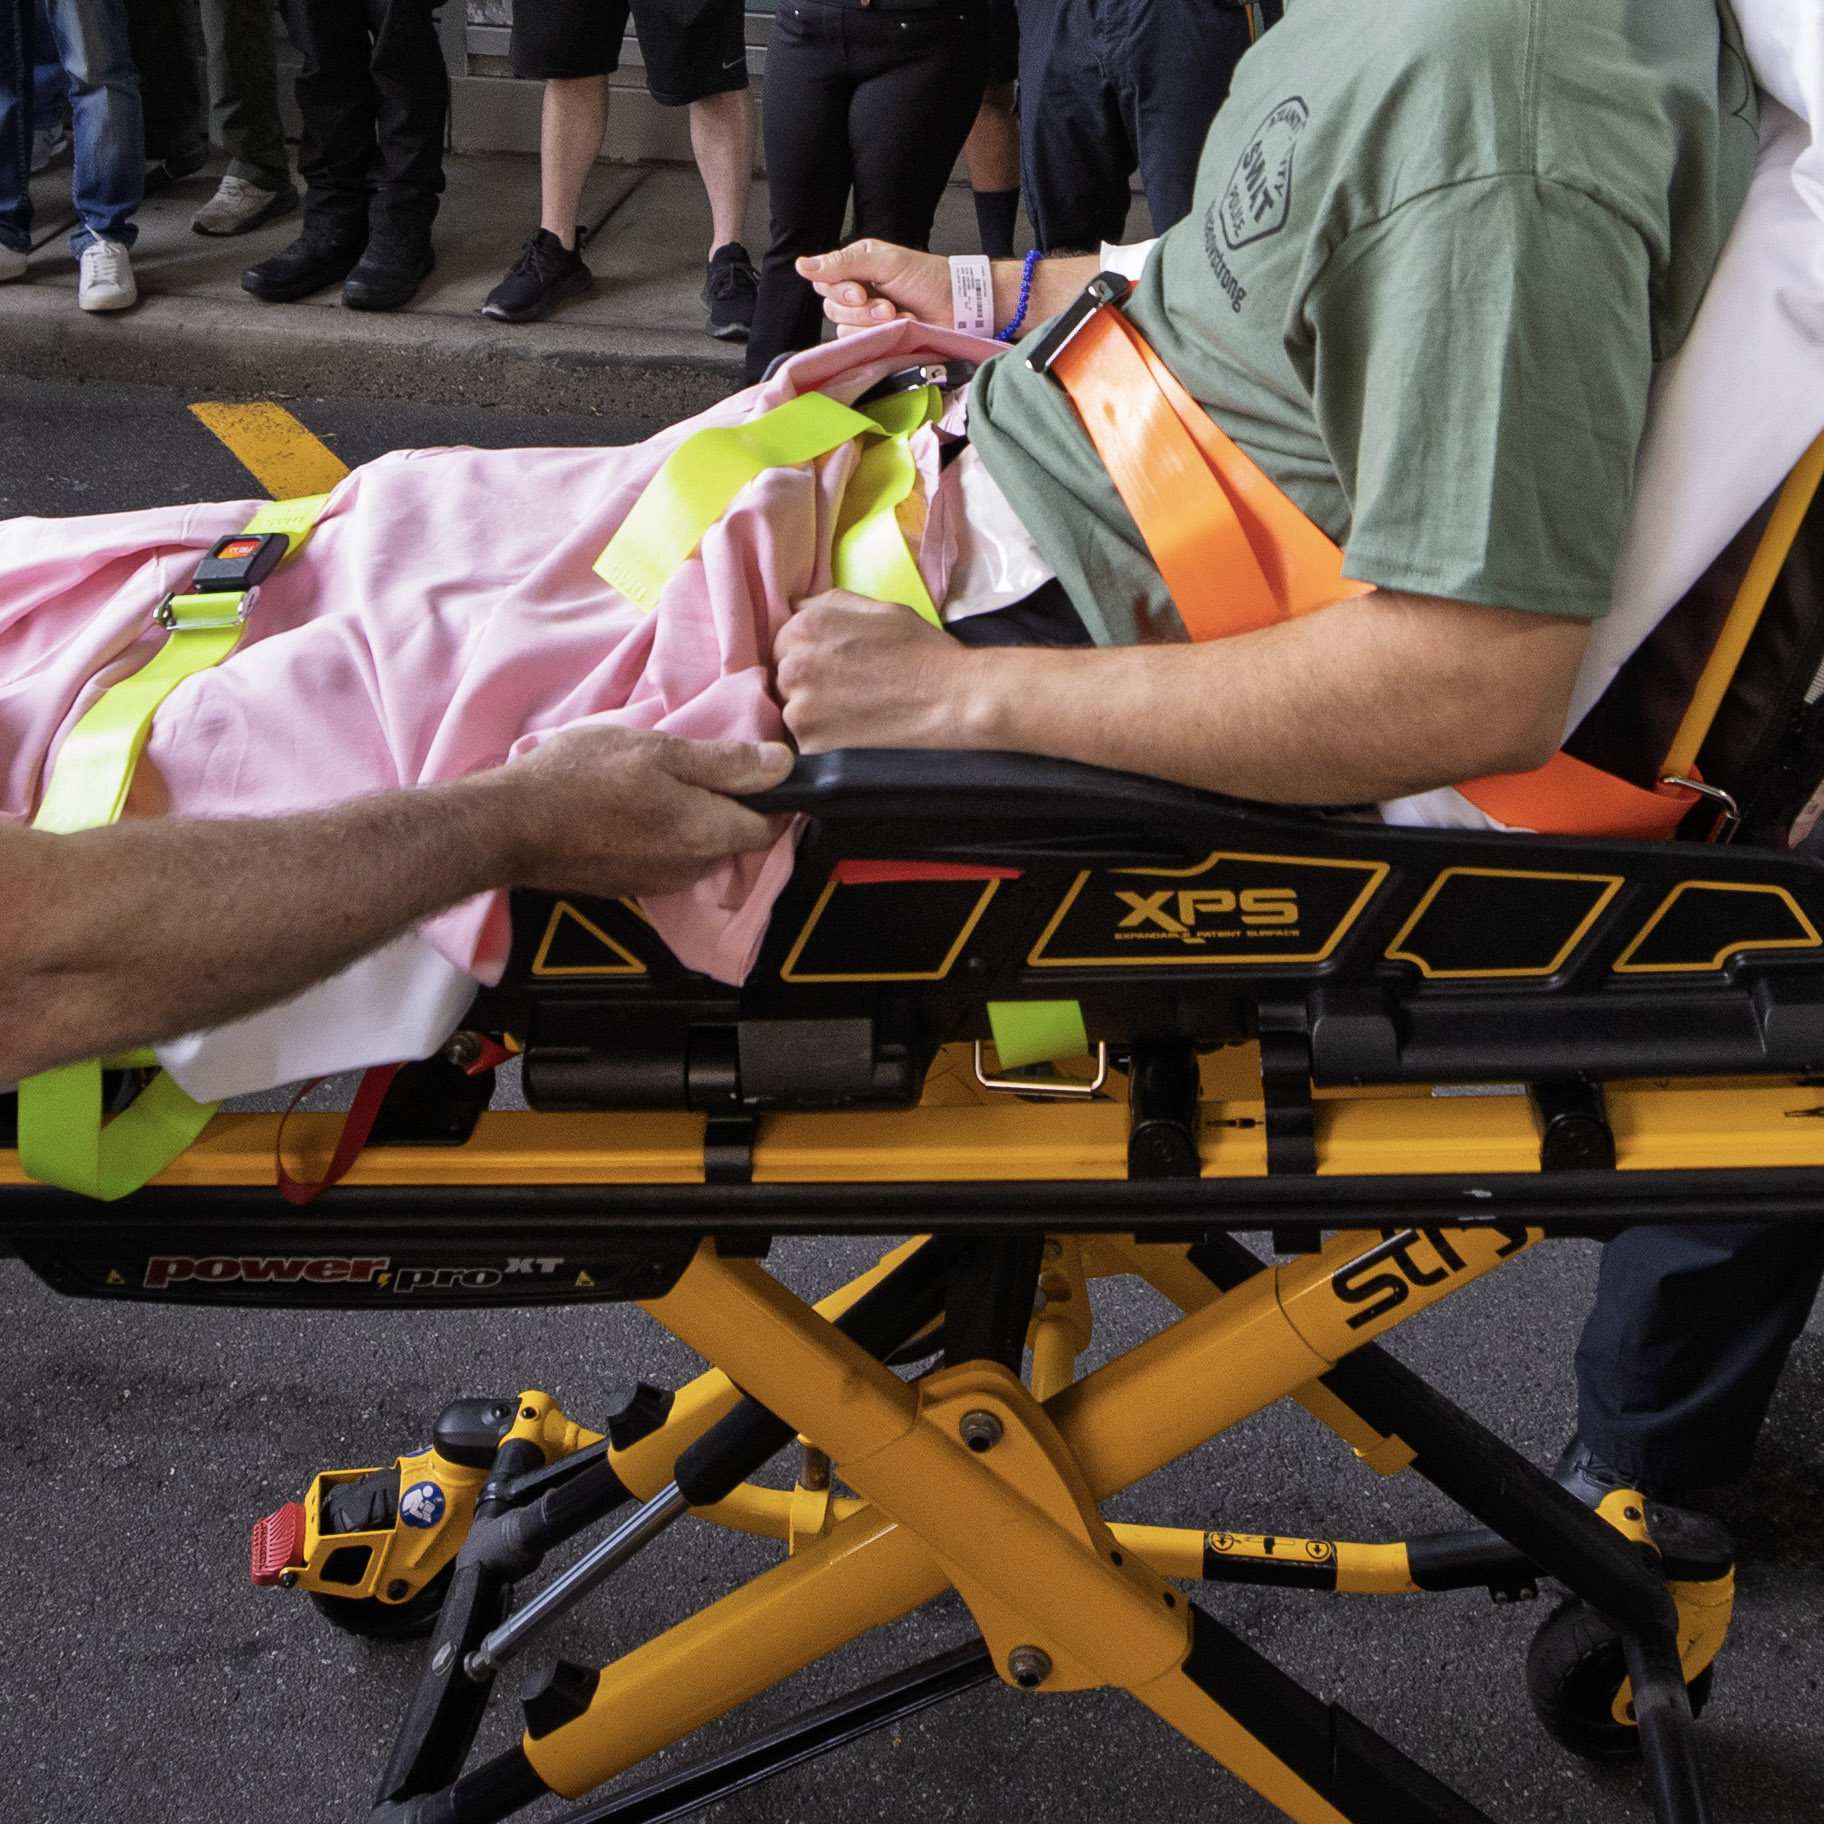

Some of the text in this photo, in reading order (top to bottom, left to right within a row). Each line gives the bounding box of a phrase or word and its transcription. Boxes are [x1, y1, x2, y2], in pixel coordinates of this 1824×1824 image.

[1114, 888, 1299, 944] XPS
[1197, 929, 1242, 939] PATIENT
[143, 1256, 565, 1293] power pro XT
